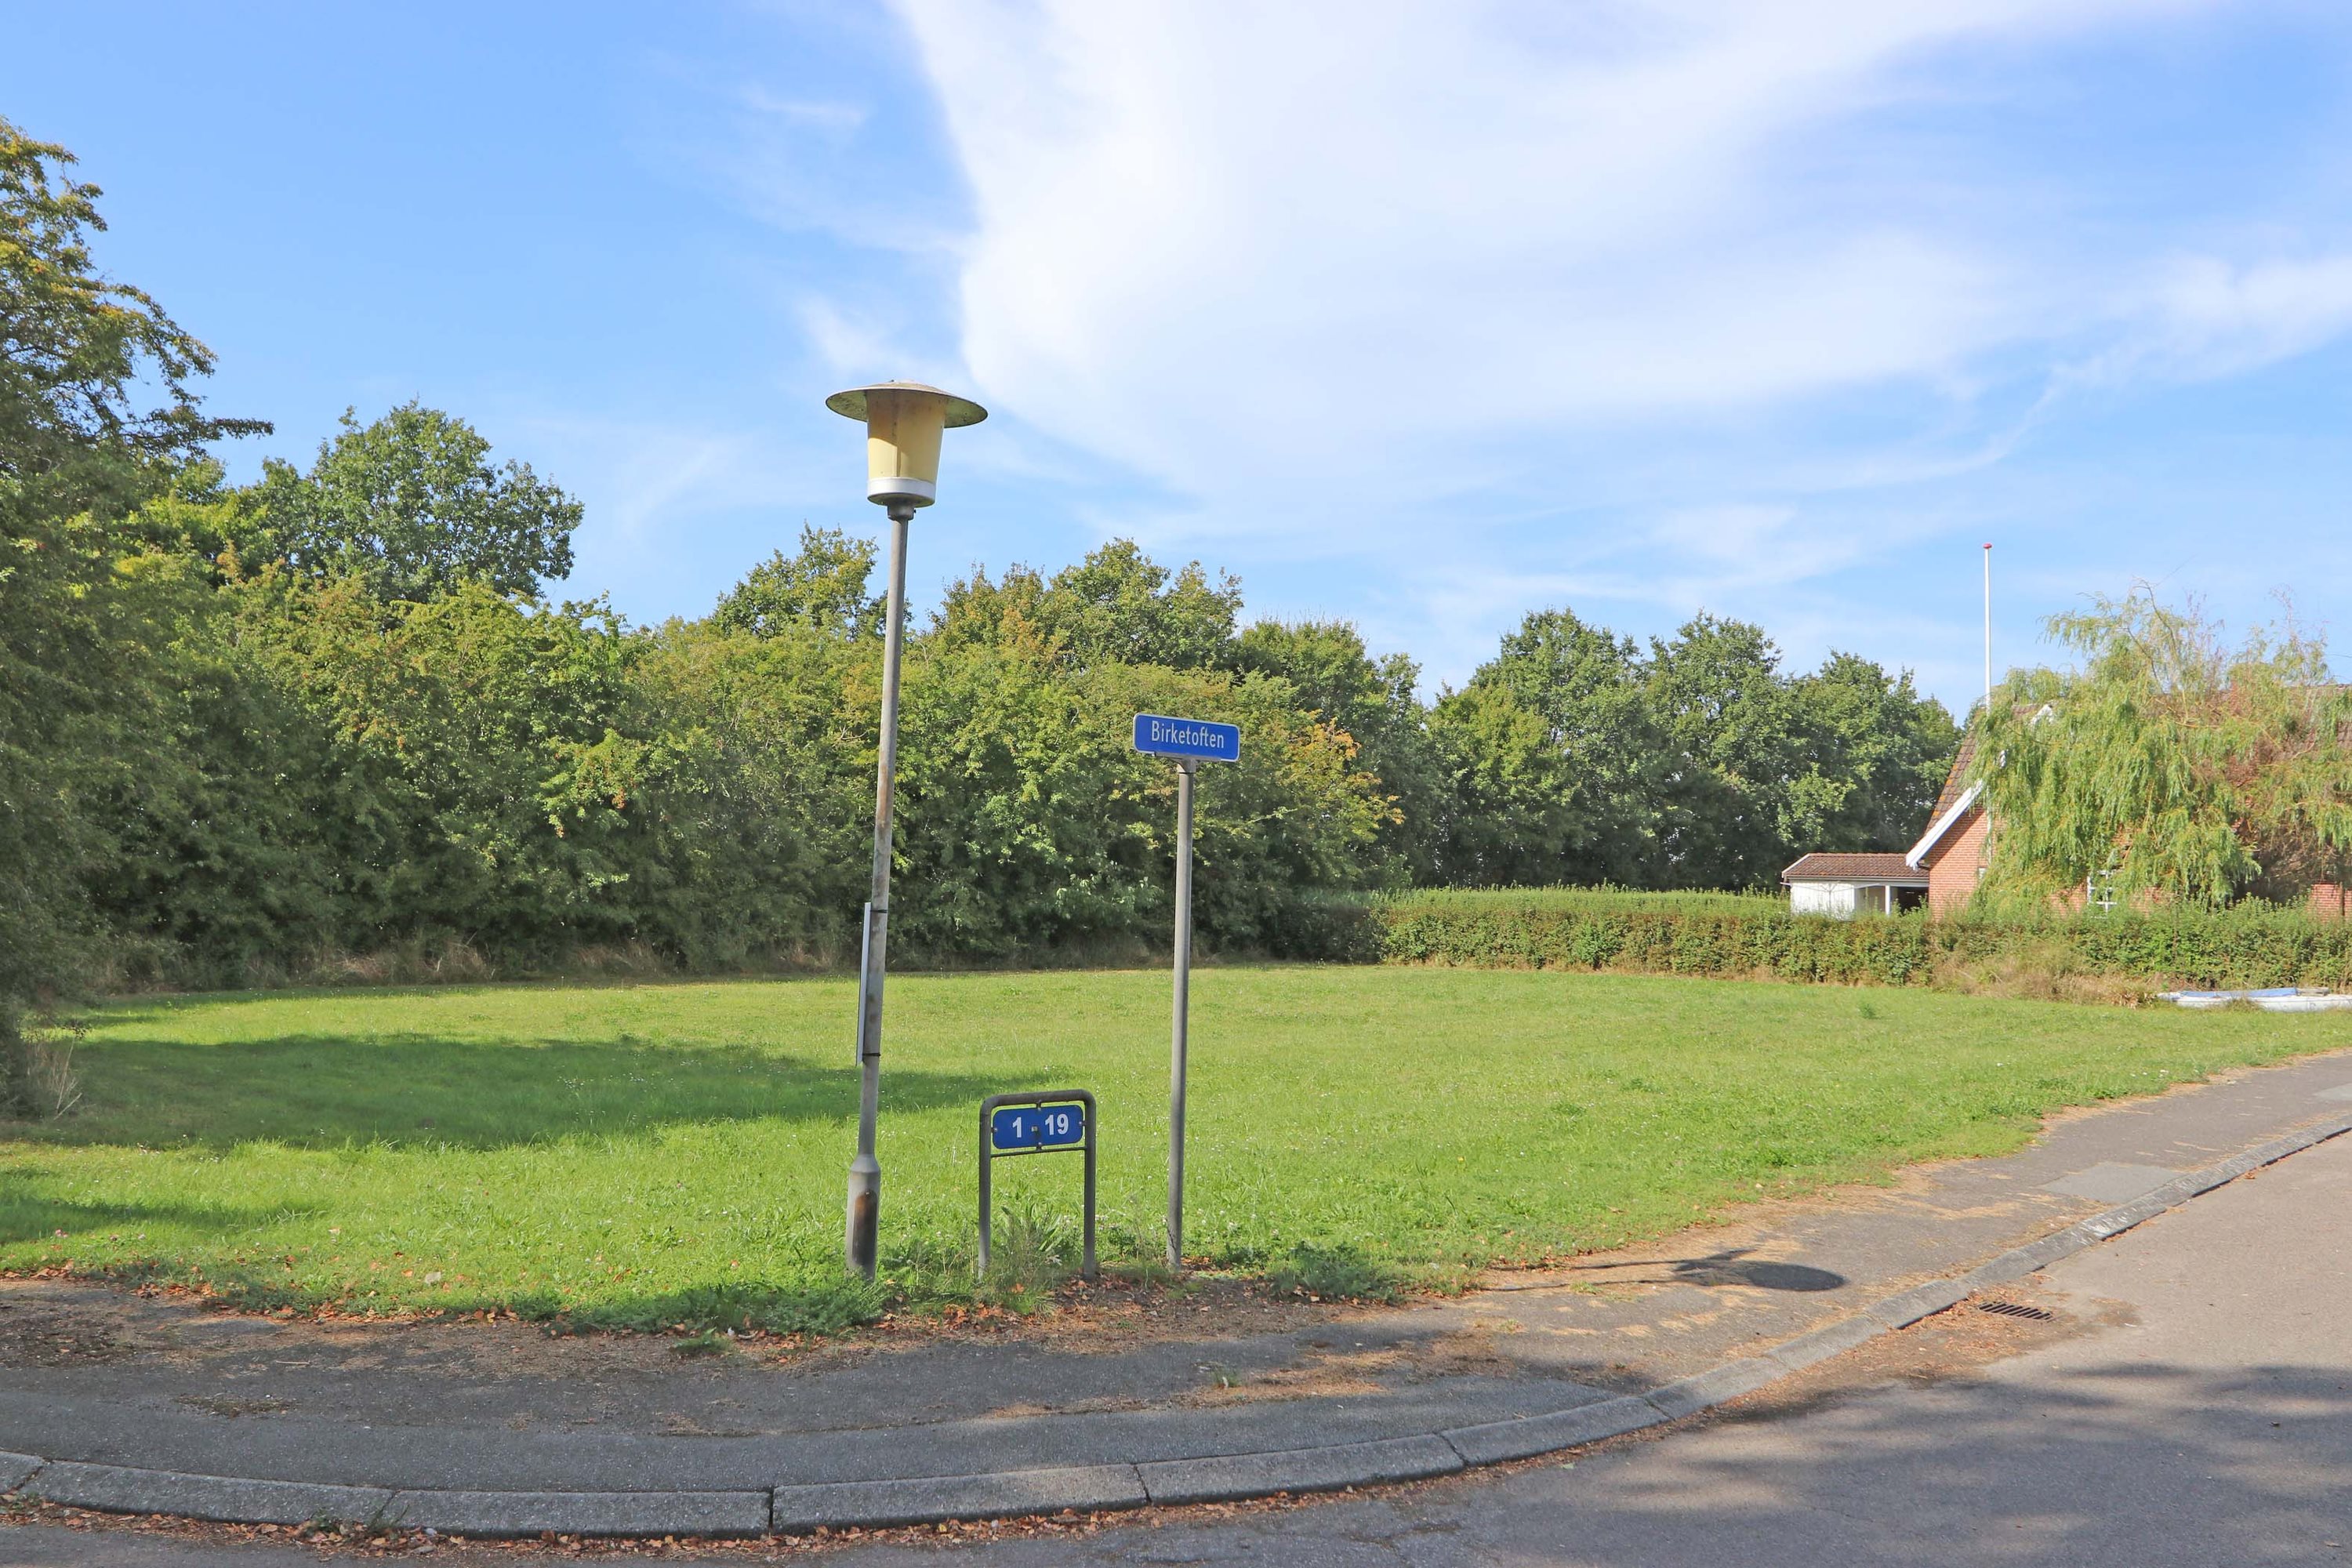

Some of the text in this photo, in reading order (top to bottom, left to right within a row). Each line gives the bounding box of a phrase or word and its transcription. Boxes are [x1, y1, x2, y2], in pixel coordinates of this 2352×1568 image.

[1152, 720, 1225, 748] Birketoften
[1012, 1117, 1022, 1138] 1
[1045, 1113, 1069, 1136] 19
